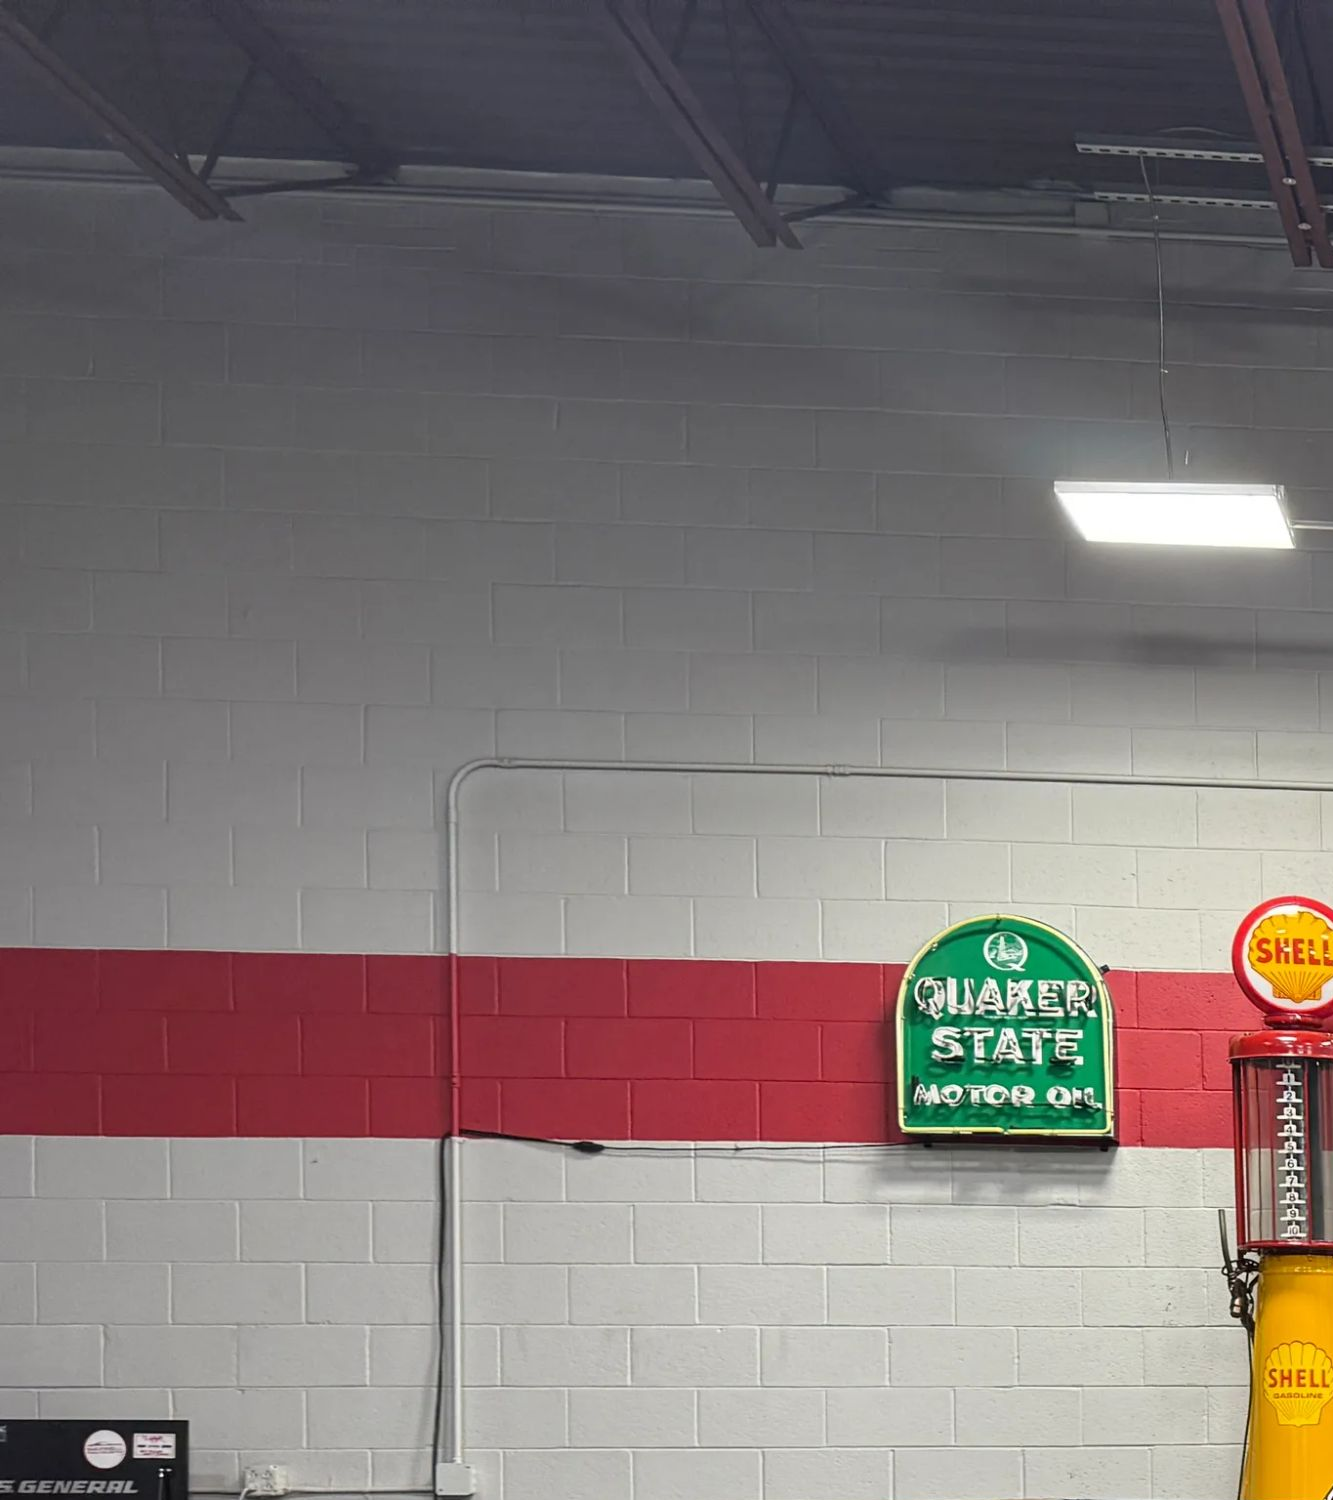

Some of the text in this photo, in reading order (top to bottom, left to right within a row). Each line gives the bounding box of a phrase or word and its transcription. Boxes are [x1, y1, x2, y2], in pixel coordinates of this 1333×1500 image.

[914, 976, 1098, 1020] QUAKER
[931, 1026, 1084, 1065] STATE
[913, 1083, 1103, 1109] MOTOR OIL
[1267, 1367, 1331, 1389] SHELL
[1273, 1391, 1324, 1400] GASOLINE
[17, 1479, 139, 1495] GENERAL
